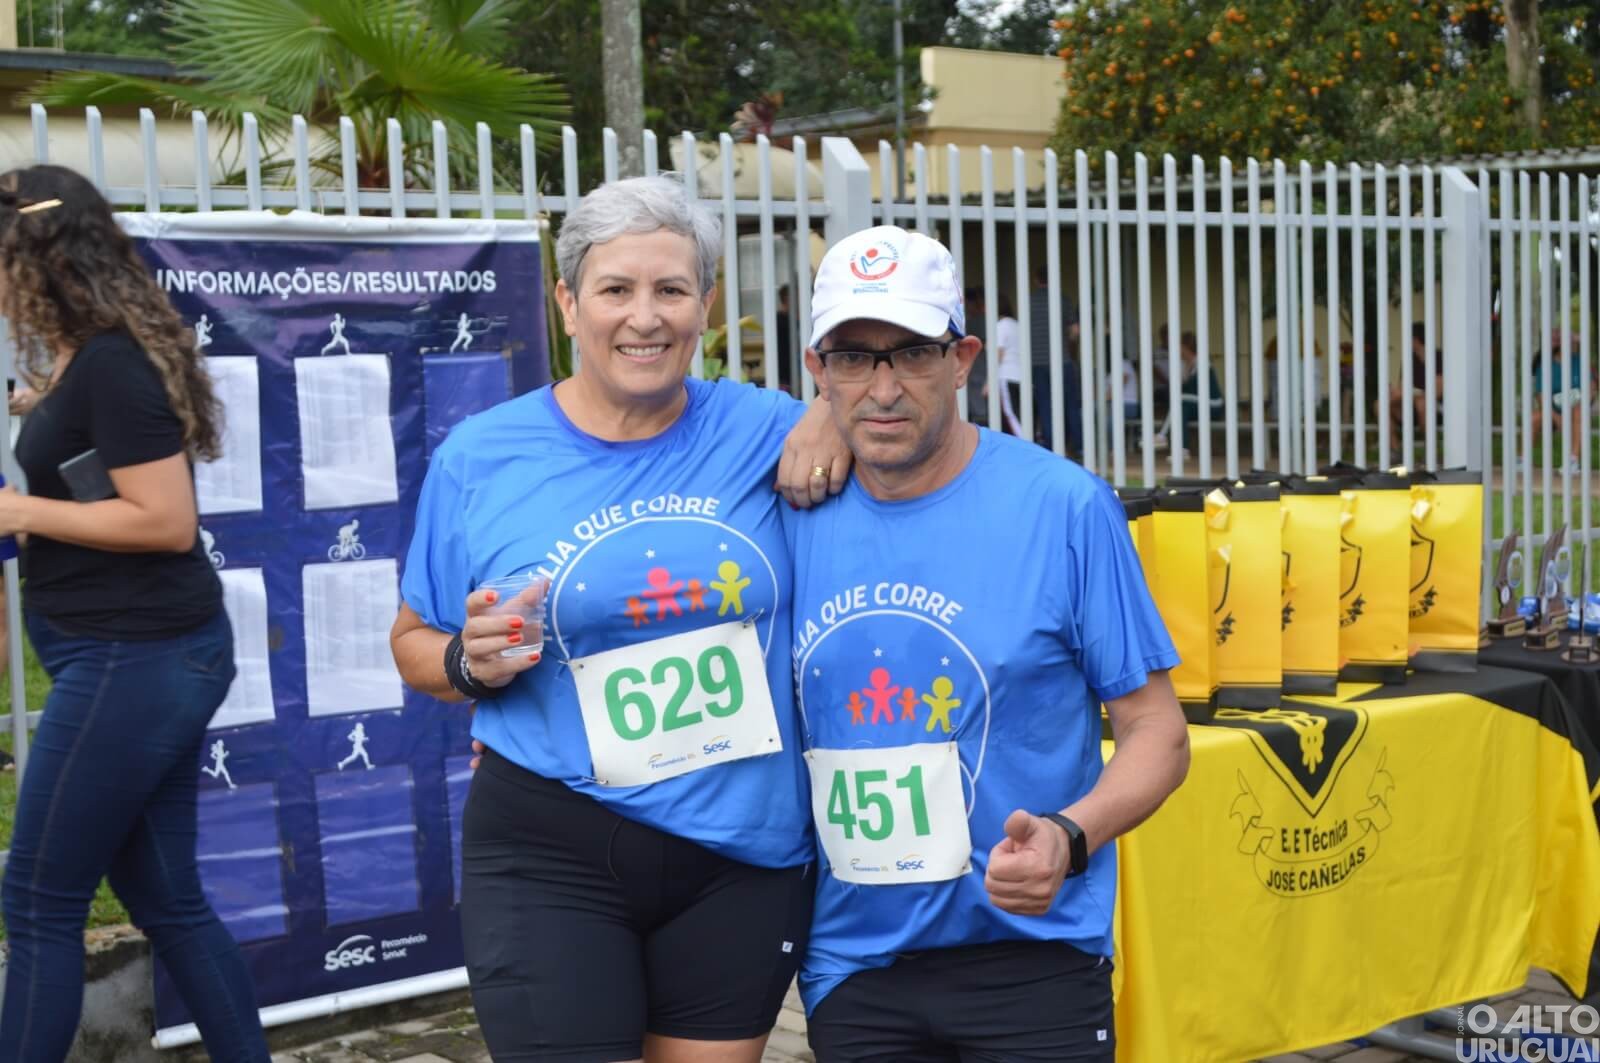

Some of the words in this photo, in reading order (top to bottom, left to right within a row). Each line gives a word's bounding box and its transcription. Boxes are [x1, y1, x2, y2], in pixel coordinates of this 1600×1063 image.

[156, 267, 497, 299] INFORMAÇÕES/RESULTADOS
[573, 504, 626, 541] QUE
[631, 493, 720, 517] CORRE
[820, 584, 868, 625] QUE
[874, 582, 963, 625] CORRE
[604, 645, 744, 741] 629
[827, 765, 931, 841] 451
[1303, 819, 1348, 853] Técnica
[1266, 866, 1296, 892] JOSÉ
[1299, 846, 1366, 891] CAÑELLAS
